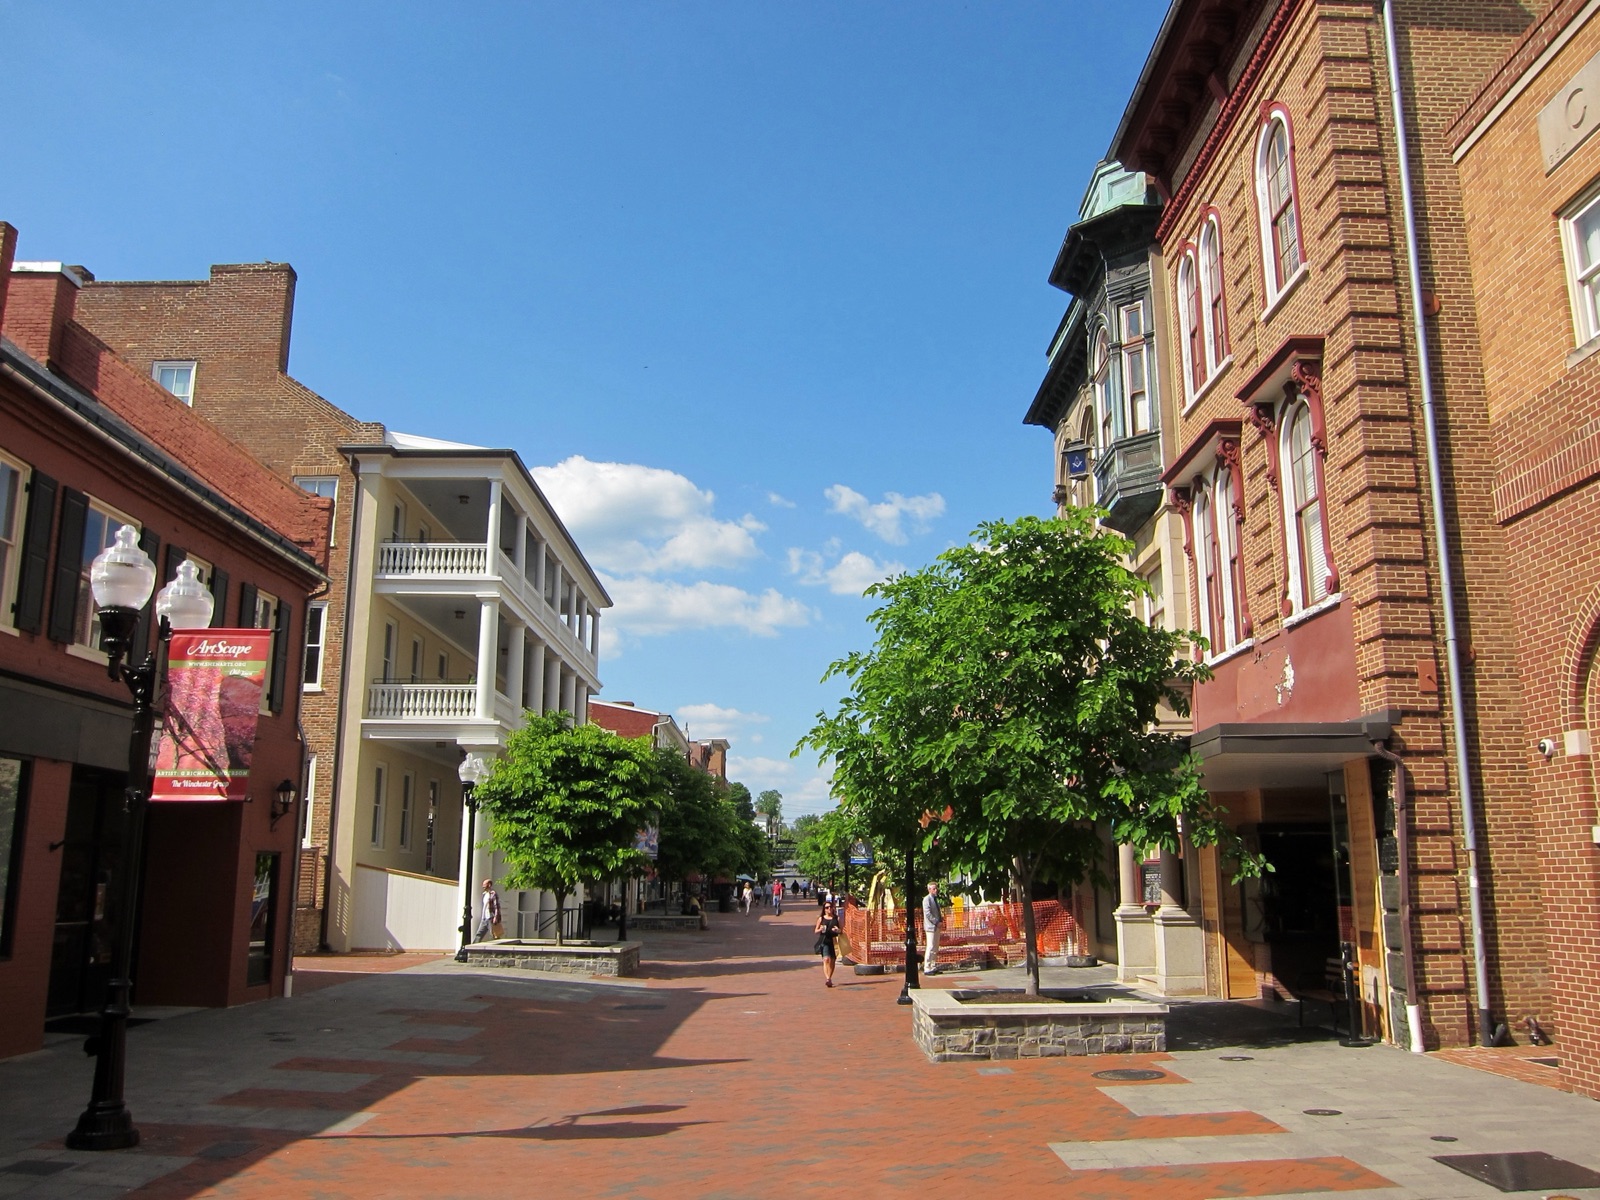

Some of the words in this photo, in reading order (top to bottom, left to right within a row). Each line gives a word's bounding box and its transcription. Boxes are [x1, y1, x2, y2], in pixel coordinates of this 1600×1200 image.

[187, 640, 252, 657] ArtScape
[172, 780, 182, 788] The
[183, 780, 212, 788] Winchester
